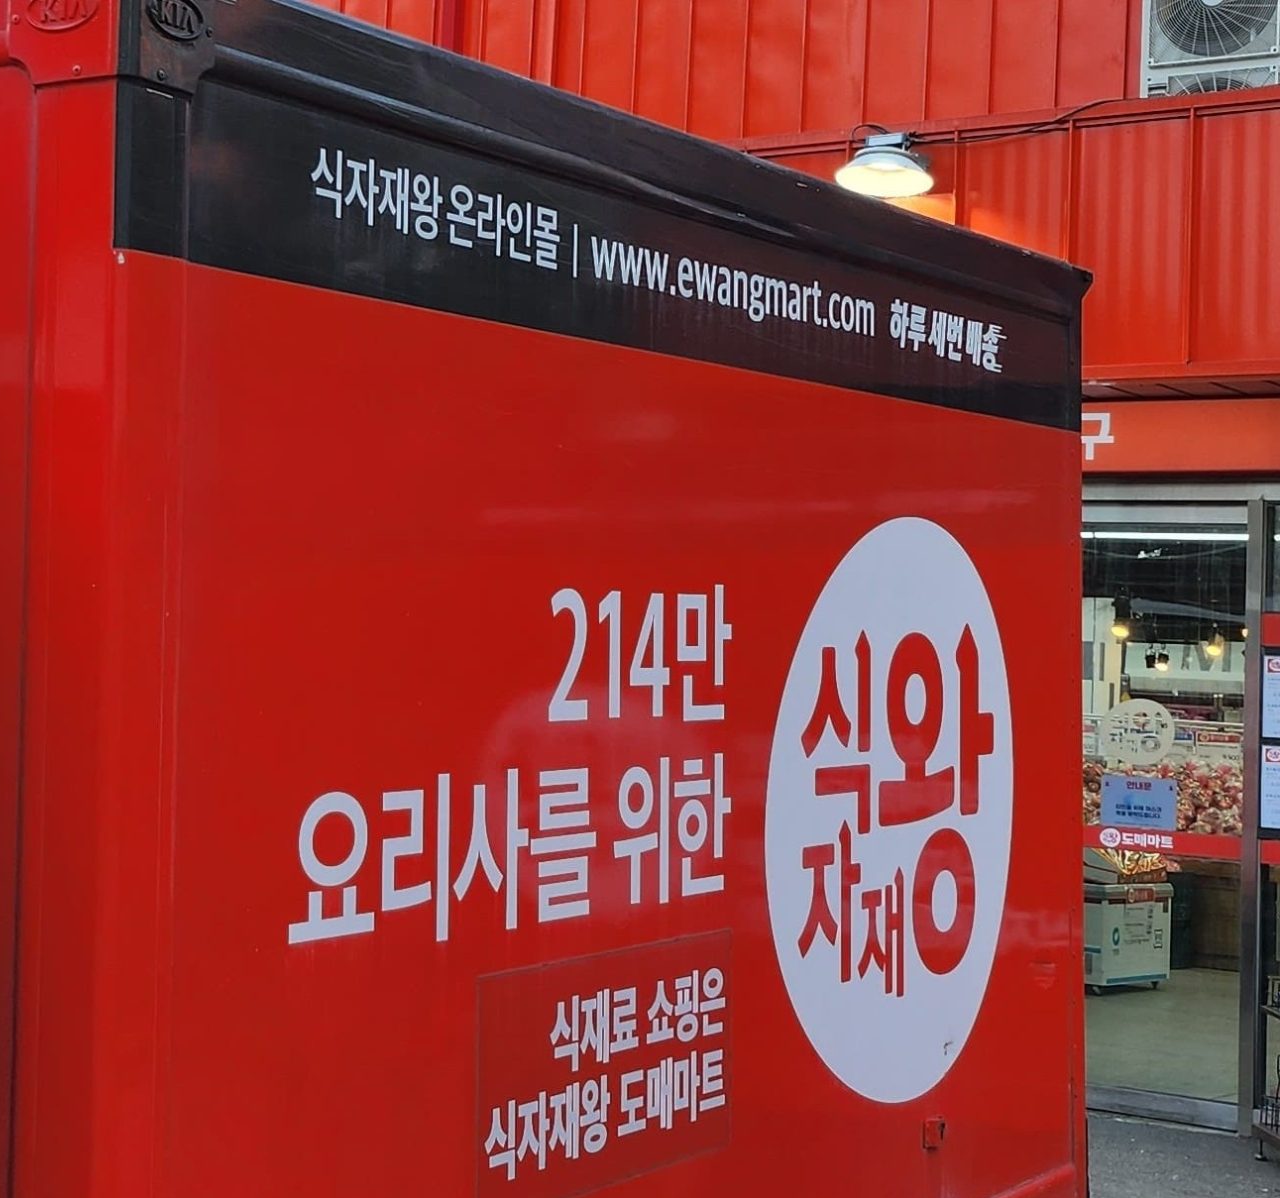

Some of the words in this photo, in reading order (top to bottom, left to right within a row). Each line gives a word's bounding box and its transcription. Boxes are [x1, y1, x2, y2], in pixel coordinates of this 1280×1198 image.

[310, 147, 444, 240] 식자재왕
[446, 184, 561, 270] 온라인몰
[590, 235, 875, 337] www.ewangmart.com
[889, 298, 927, 352] 하루
[547, 583, 733, 722] 214만
[288, 767, 598, 945] 요리사를
[613, 752, 732, 905] 위한
[1121, 831, 1174, 849] 도매마트
[549, 987, 640, 1073] 식재료
[645, 966, 727, 1045] 쇼핑은
[484, 1078, 610, 1182] 식자재왕
[616, 1047, 727, 1138] 도매마트
